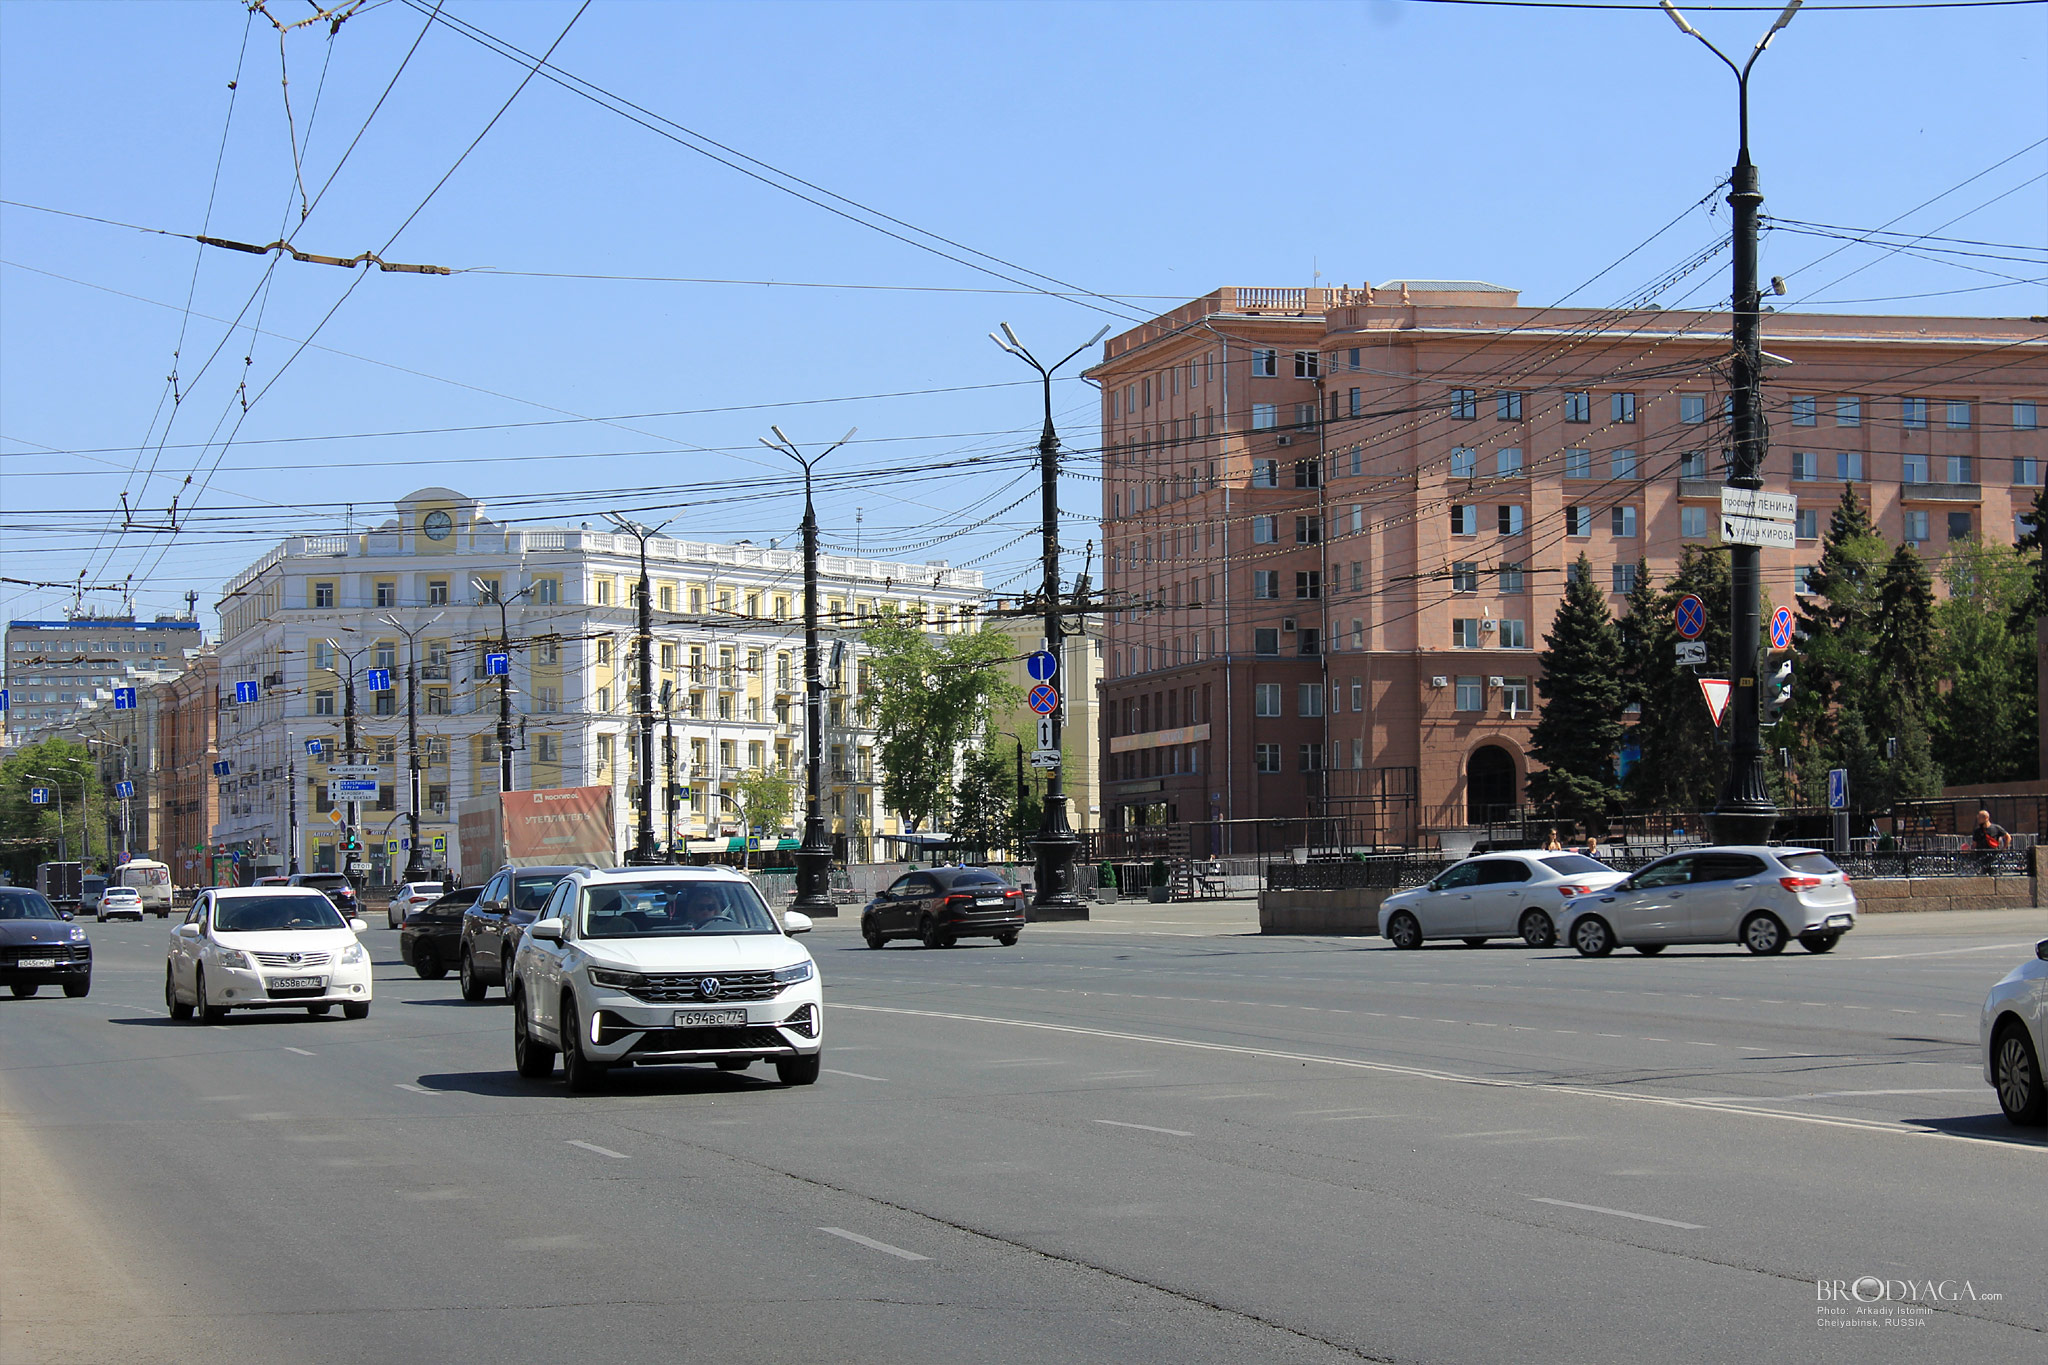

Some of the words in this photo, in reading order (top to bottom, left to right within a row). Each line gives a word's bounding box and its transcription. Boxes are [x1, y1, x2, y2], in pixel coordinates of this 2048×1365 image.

[1724, 498, 1756, 508] проспект
[1757, 499, 1794, 513] ЛЕНИНА
[1736, 527, 1760, 538] улица
[1761, 528, 1794, 541] КИРОВА
[525, 812, 591, 825] УТЕПЛИТЕЛЬ
